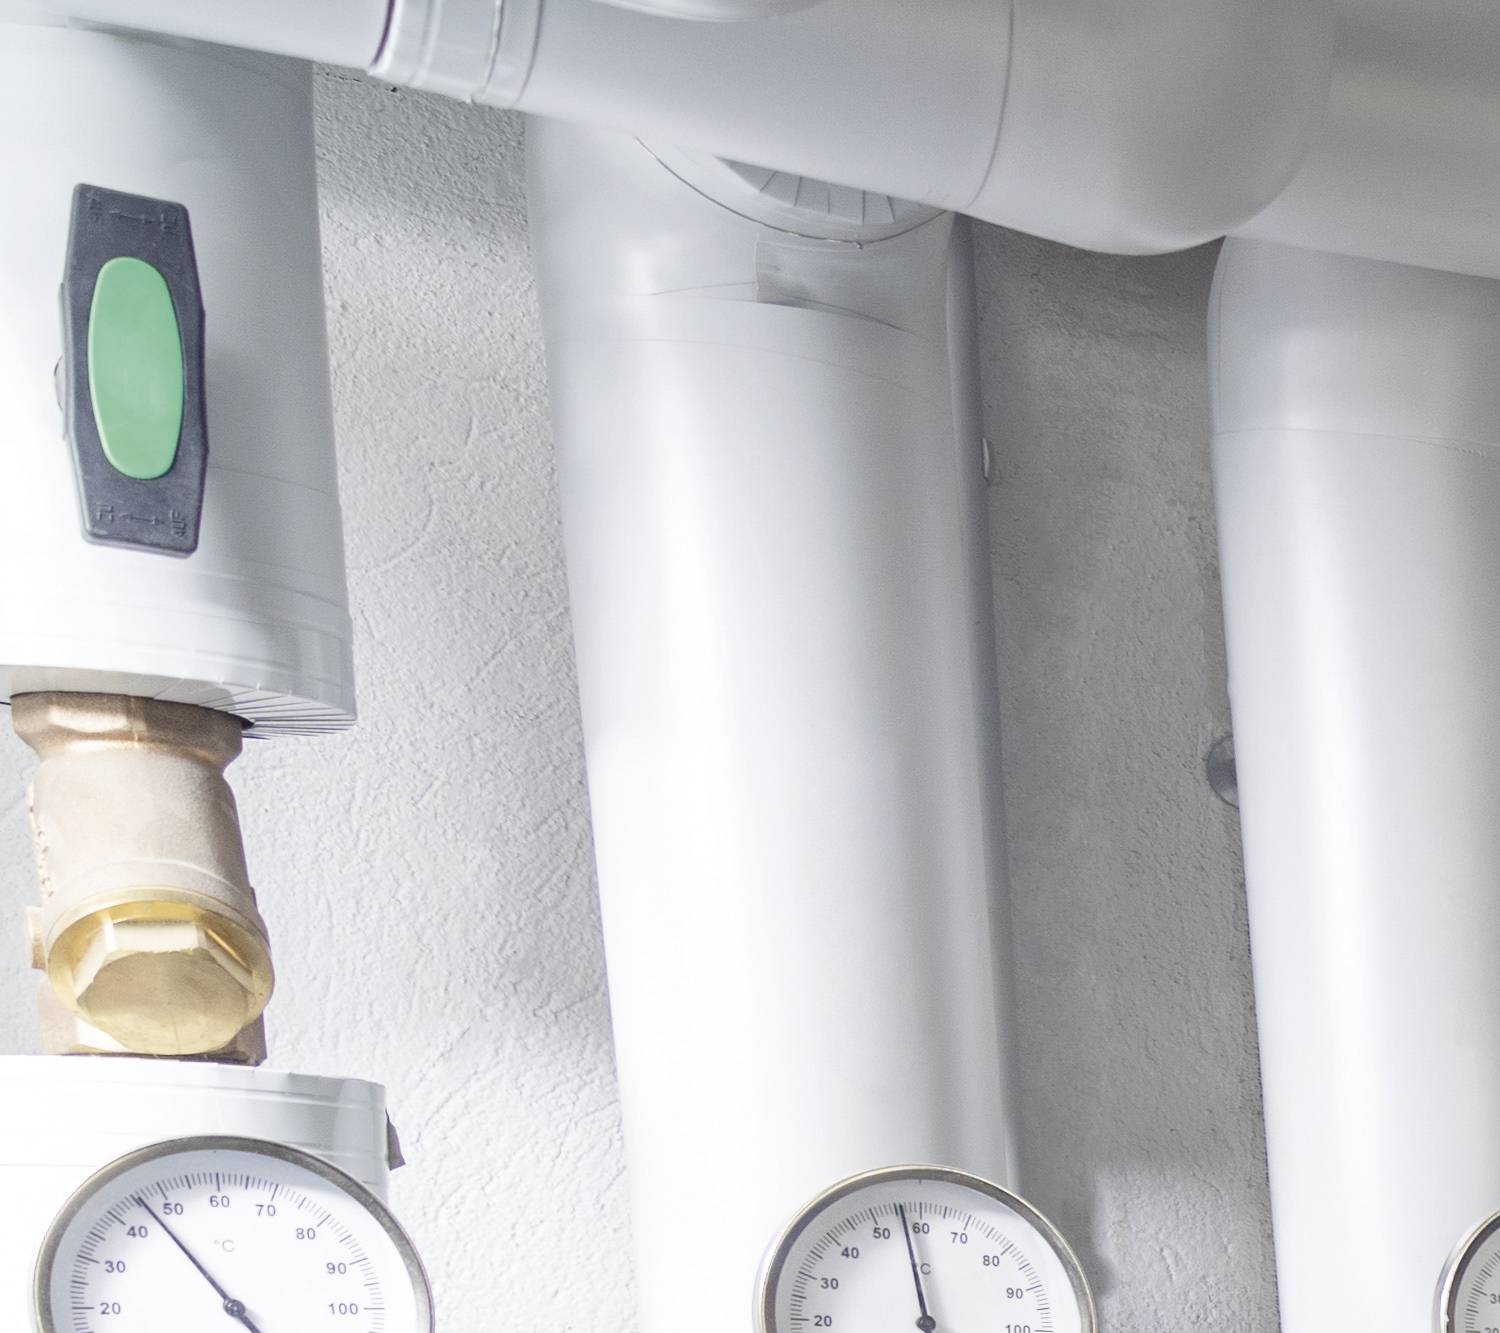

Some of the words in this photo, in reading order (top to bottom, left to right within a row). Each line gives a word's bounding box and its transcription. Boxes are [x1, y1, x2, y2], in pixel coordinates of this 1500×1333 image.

[209, 1195, 230, 1208] 60
[163, 1203, 184, 1215] 50
[255, 1204, 277, 1217] 70
[126, 1226, 148, 1239] 40
[295, 1228, 316, 1241] 80
[873, 1227, 891, 1239] 50
[912, 1223, 930, 1235] 60
[950, 1232, 968, 1245] 70
[213, 1239, 235, 1253] °C
[841, 1247, 860, 1259] 40
[105, 1261, 126, 1274] 30
[982, 1255, 1000, 1267] 80
[326, 1262, 347, 1275] 90
[820, 1278, 839, 1290] 30
[1006, 1288, 1024, 1300] 90
[100, 1302, 121, 1315] 20
[328, 1303, 359, 1316] 100
[814, 1315, 833, 1327] 20
